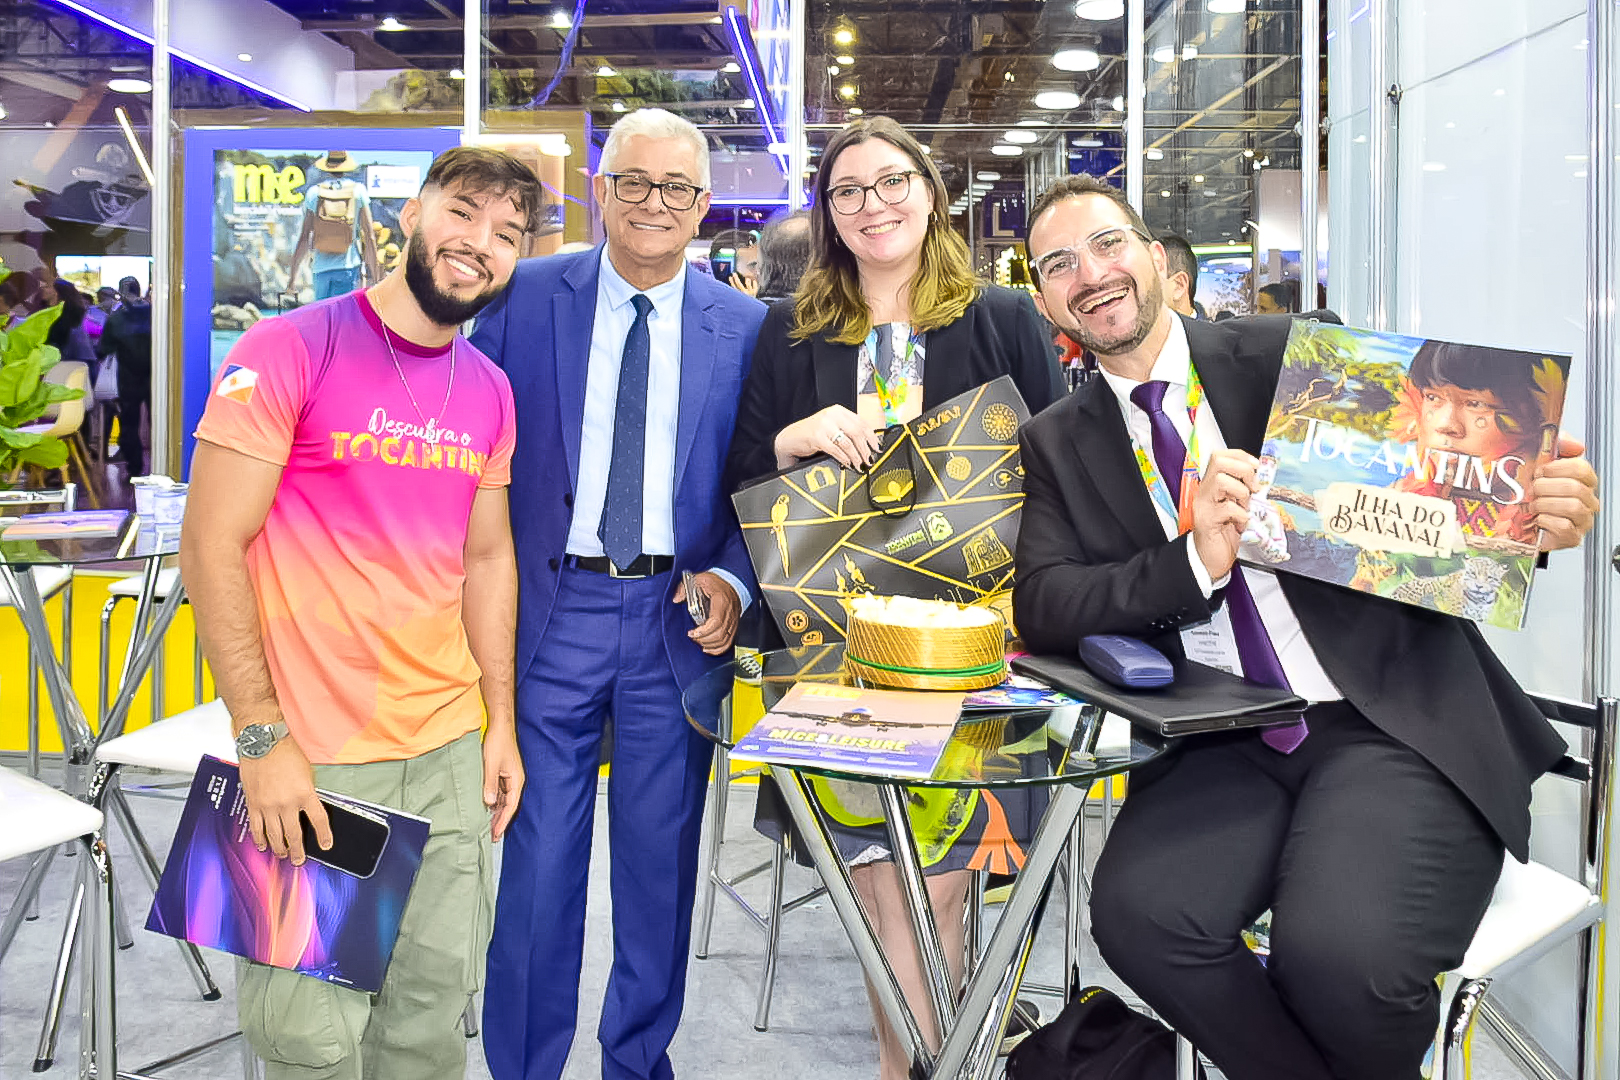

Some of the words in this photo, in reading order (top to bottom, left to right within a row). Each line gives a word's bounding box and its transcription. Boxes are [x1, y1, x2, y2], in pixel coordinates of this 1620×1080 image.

[367, 407, 458, 443] Descubra
[460, 432, 472, 446] o
[331, 431, 487, 477] TOCANTIN
[1295, 414, 1526, 505] TOCANTINS
[1329, 504, 1446, 550] BANANAL
[1353, 488, 1403, 519] ILHA
[1412, 505, 1446, 528] DO
